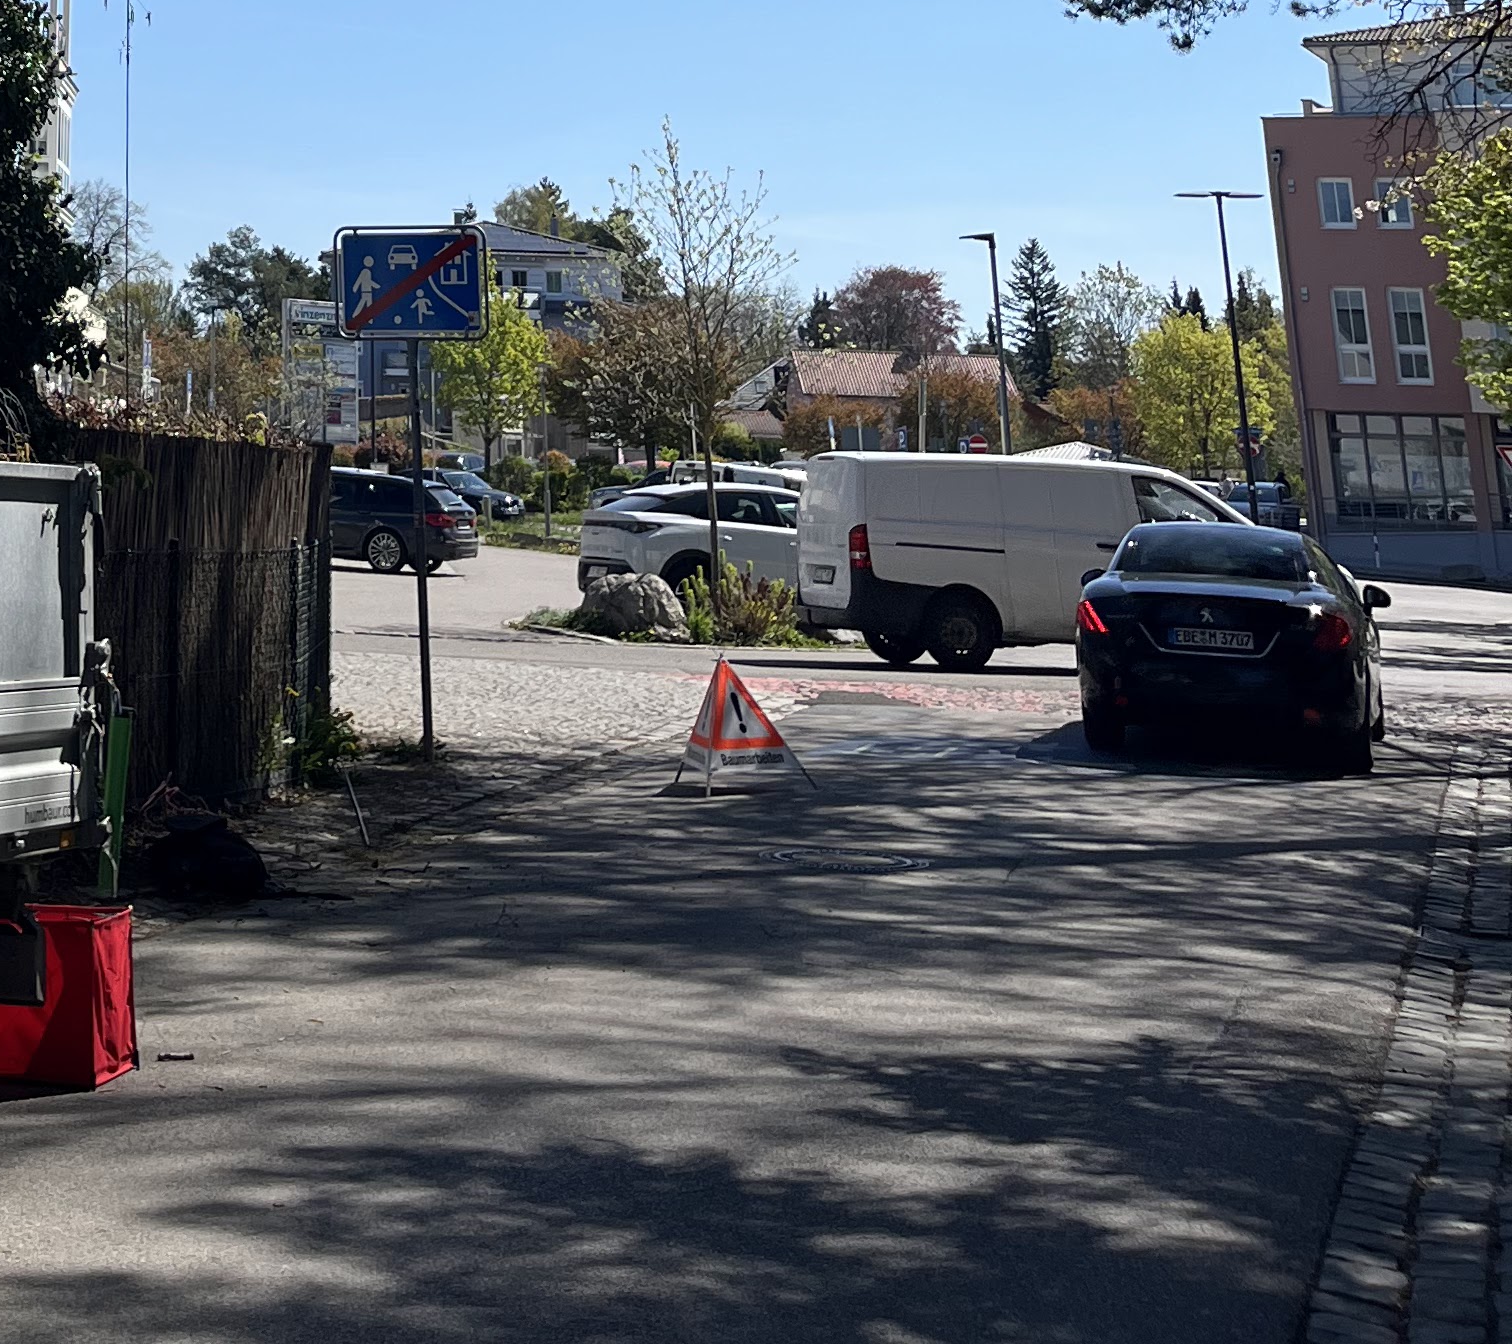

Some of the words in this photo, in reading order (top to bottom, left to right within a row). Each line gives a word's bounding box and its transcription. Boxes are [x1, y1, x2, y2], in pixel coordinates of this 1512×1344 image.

[1175, 629, 1199, 644] EBE
[1220, 633, 1252, 648] 3707
[720, 752, 785, 766] Baumarbeiten
